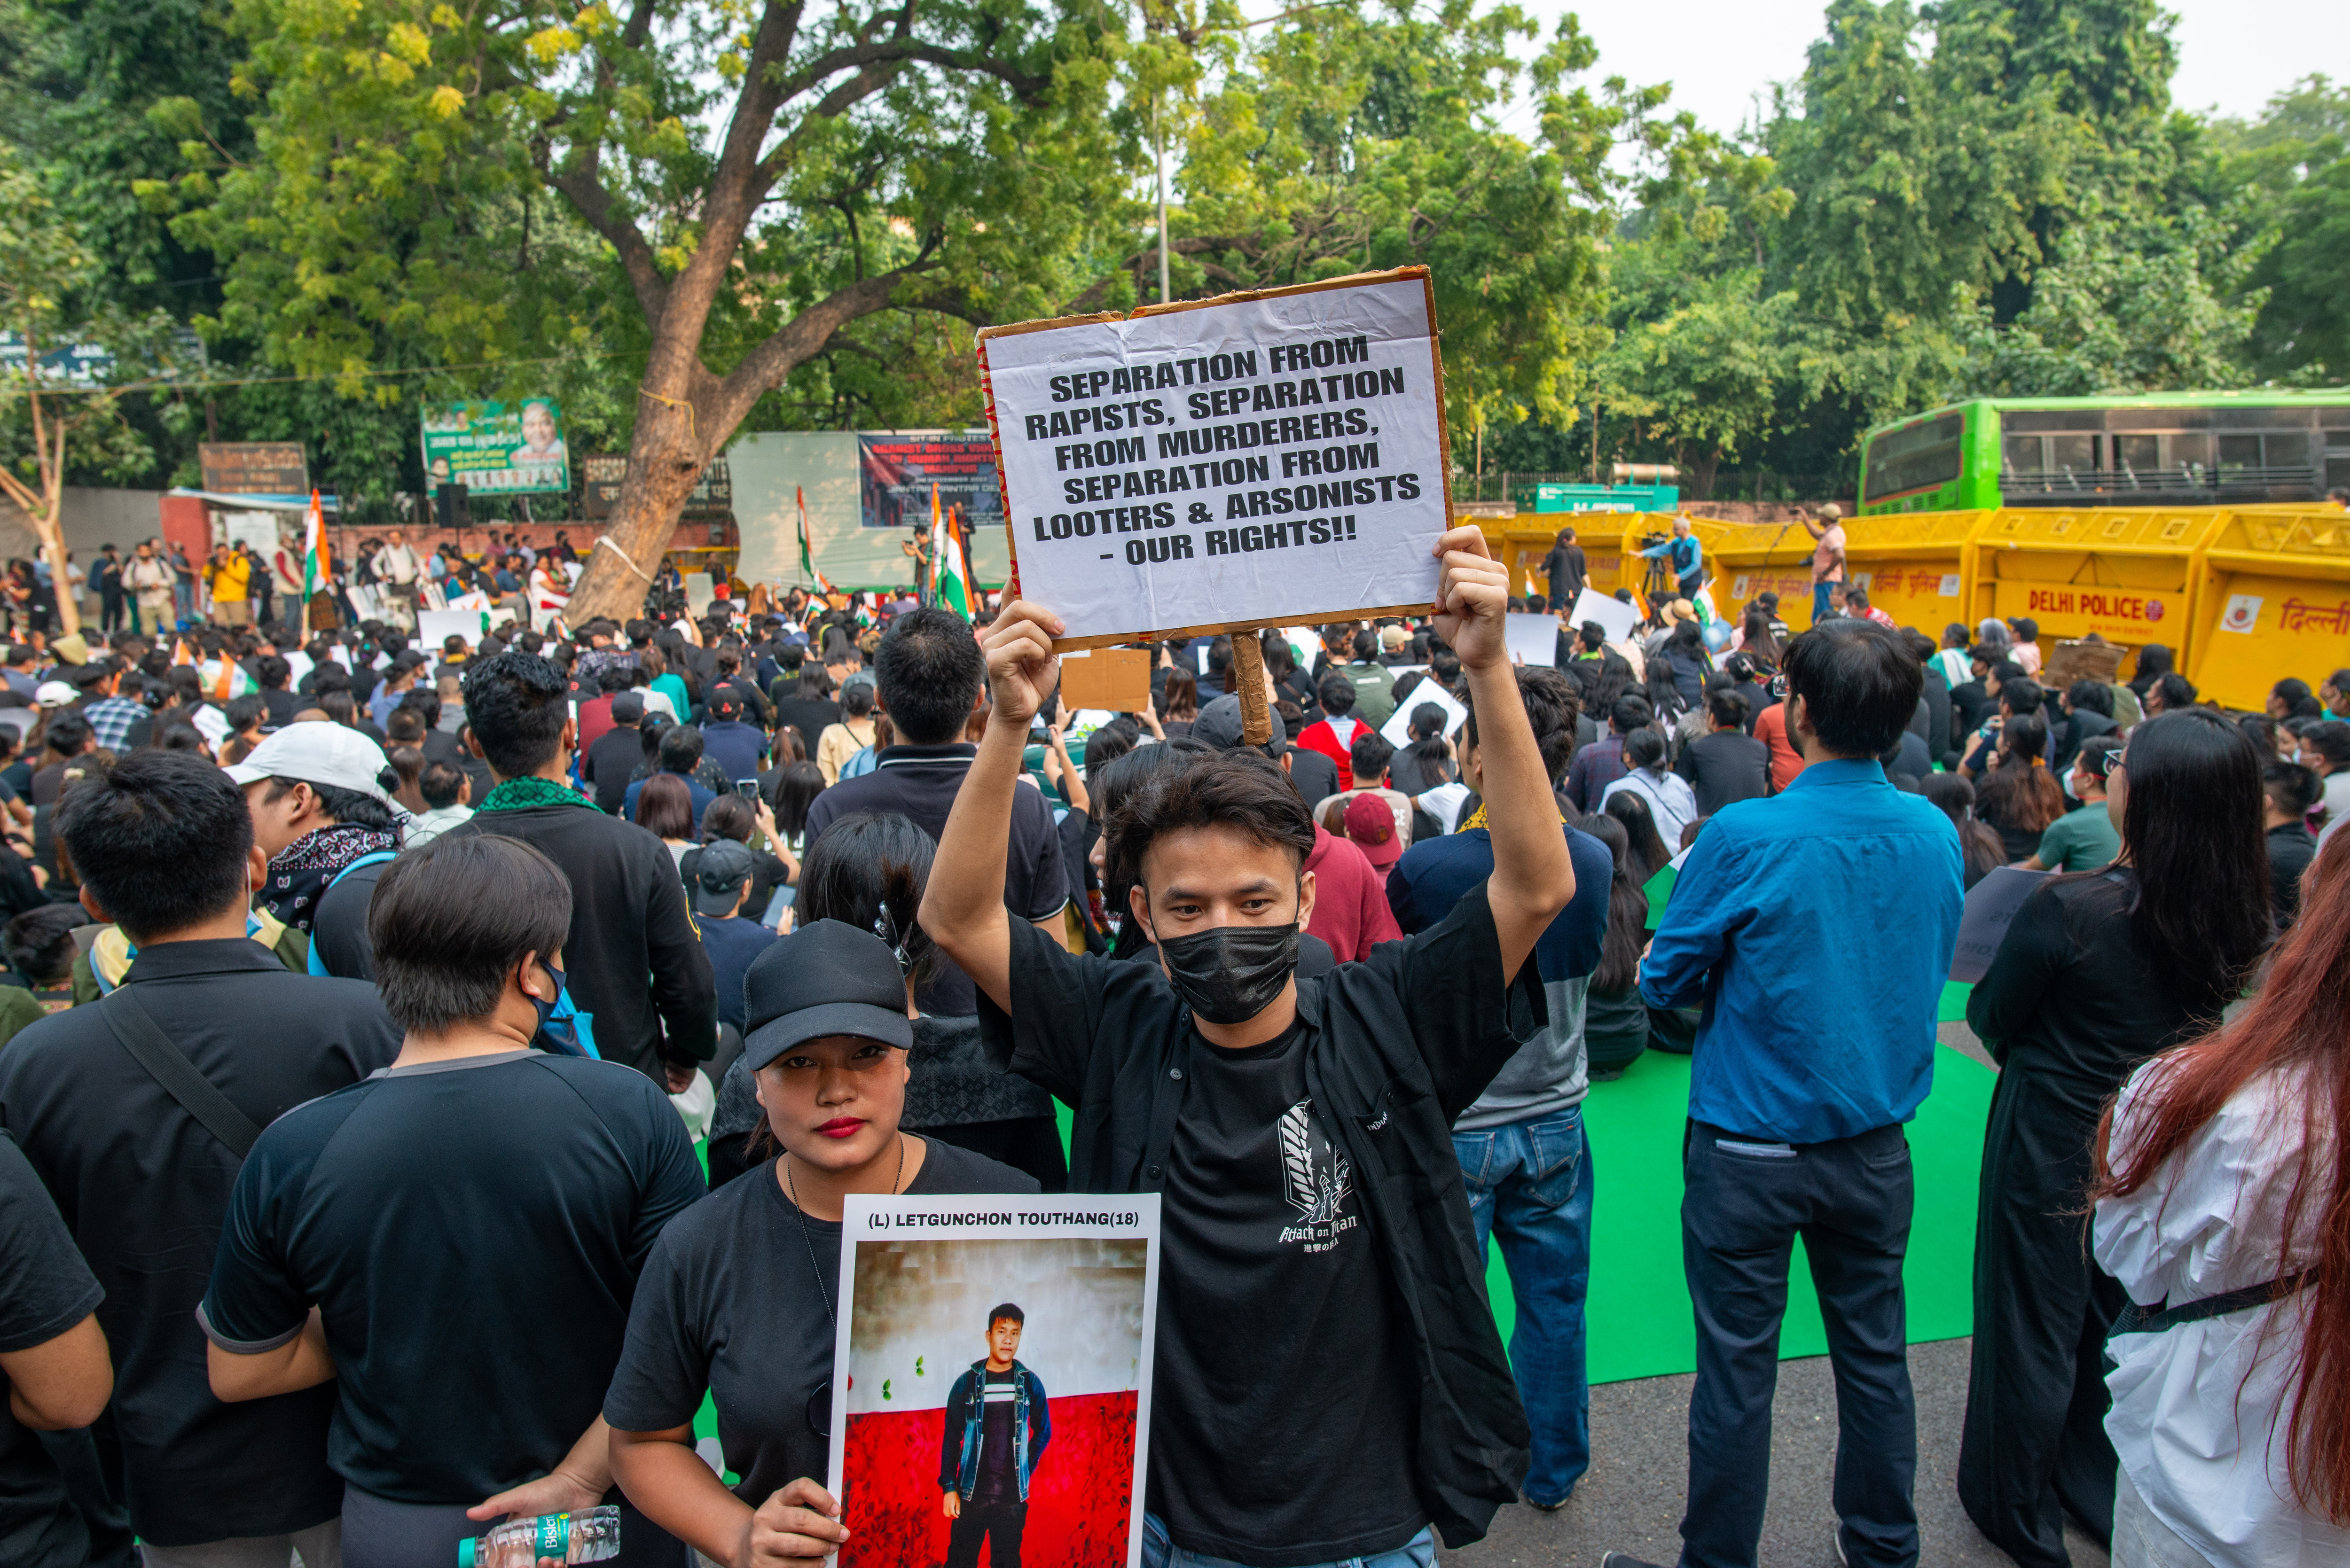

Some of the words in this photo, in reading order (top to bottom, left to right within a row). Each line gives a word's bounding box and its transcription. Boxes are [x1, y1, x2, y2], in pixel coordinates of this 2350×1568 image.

[1050, 350, 1257, 402] SEPARATION
[1269, 335, 1369, 374] FROM
[1025, 399, 1175, 440] RAPISTS,
[1188, 367, 1404, 419] SEPARATION
[872, 444, 922, 453] AGAINST
[925, 444, 964, 453] GROSS
[1055, 437, 1146, 471] FROM
[1158, 408, 1379, 459] MURDERERS,
[907, 454, 950, 463] HUMAN
[924, 464, 978, 474] MANIPUR
[1064, 455, 1269, 504] SEPARATION
[1281, 442, 1379, 478] FROM
[1034, 502, 1175, 541] LOOTERS
[1188, 502, 1214, 524] &
[1226, 474, 1420, 520] ARSONISTS
[1126, 535, 1193, 565] OUR
[1206, 515, 1356, 556] RIGHTS!!
[2029, 590, 2074, 614] DELHI
[2081, 593, 2142, 619] POLICE
[1366, 1111, 1388, 1131] INDIAN
[869, 1214, 889, 1229] (L)
[896, 1213, 1011, 1226] LETGUNCHON
[1018, 1212, 1138, 1227] TOUTHANG(18)
[1278, 1225, 1315, 1243] Attack
[1317, 1229, 1329, 1237] on
[1304, 1237, 1339, 1253] 進撃の巨人
[543, 1515, 558, 1548] Bisleri
